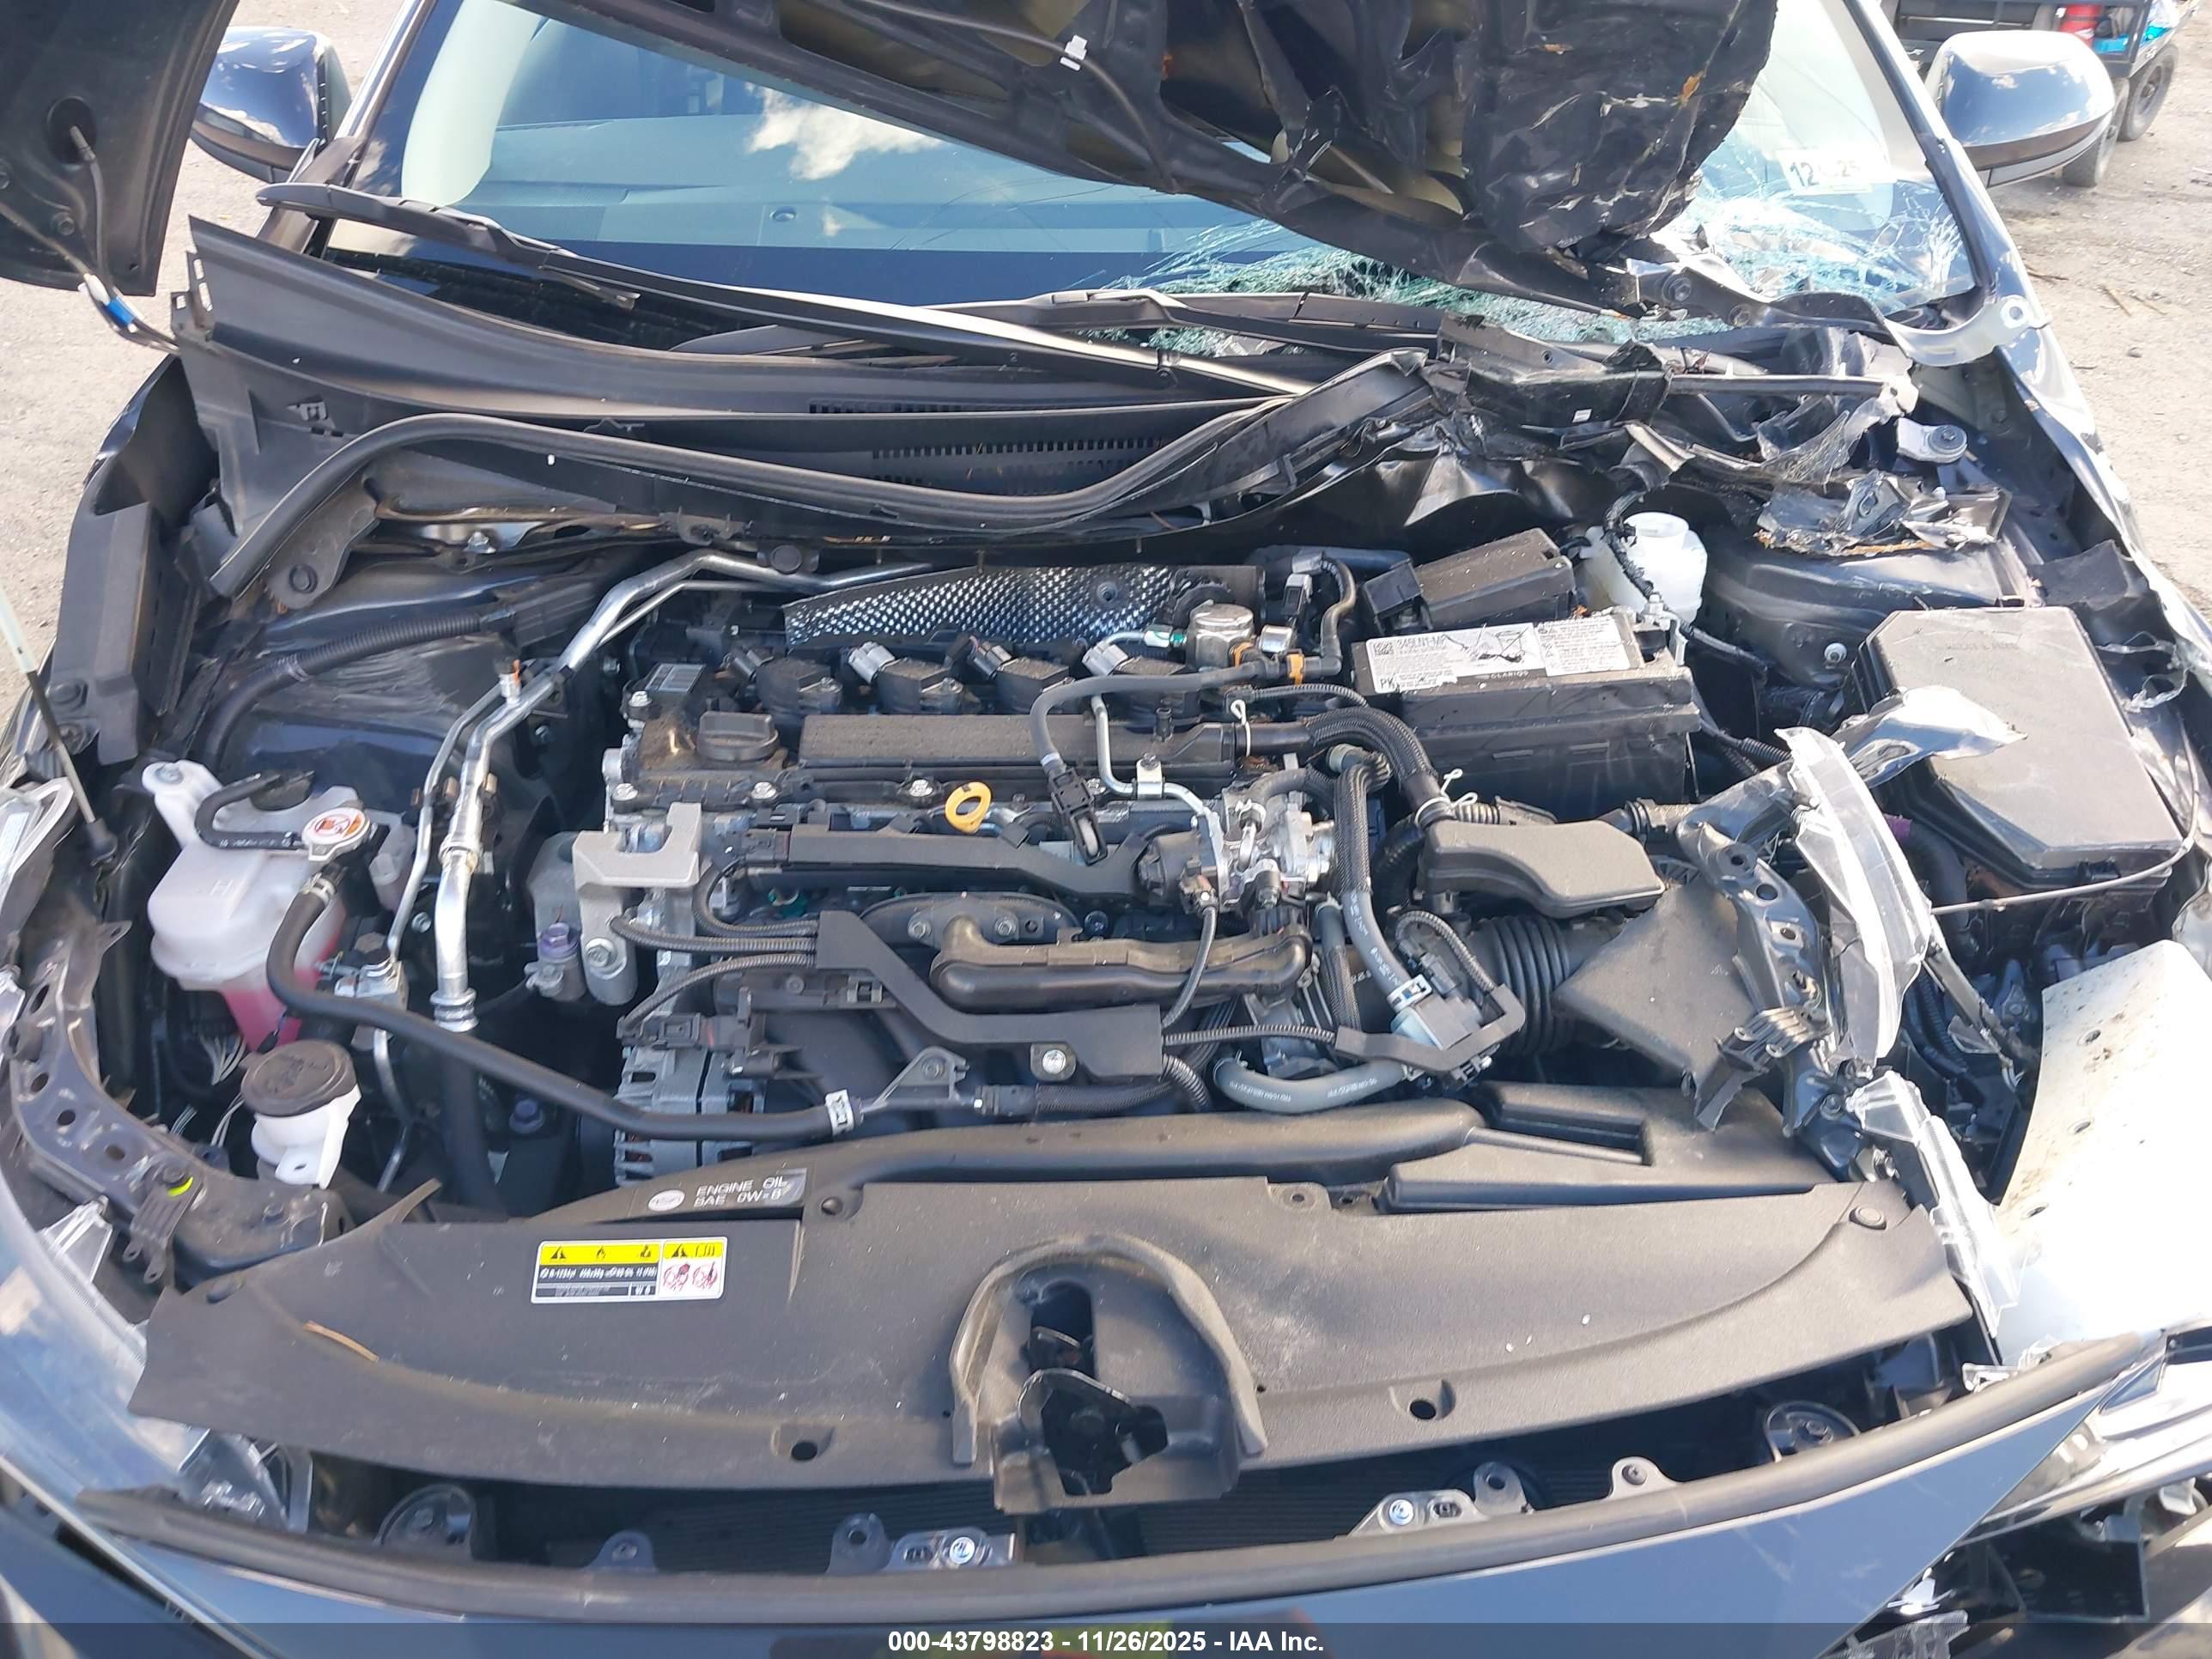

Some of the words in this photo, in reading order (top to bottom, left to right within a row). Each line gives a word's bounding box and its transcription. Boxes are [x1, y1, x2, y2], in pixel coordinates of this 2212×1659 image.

[1790, 161, 1820, 187] 12
[696, 1179, 754, 1197] ENGINE
[763, 1176, 788, 1189] OIL
[693, 1194, 726, 1207] SAE
